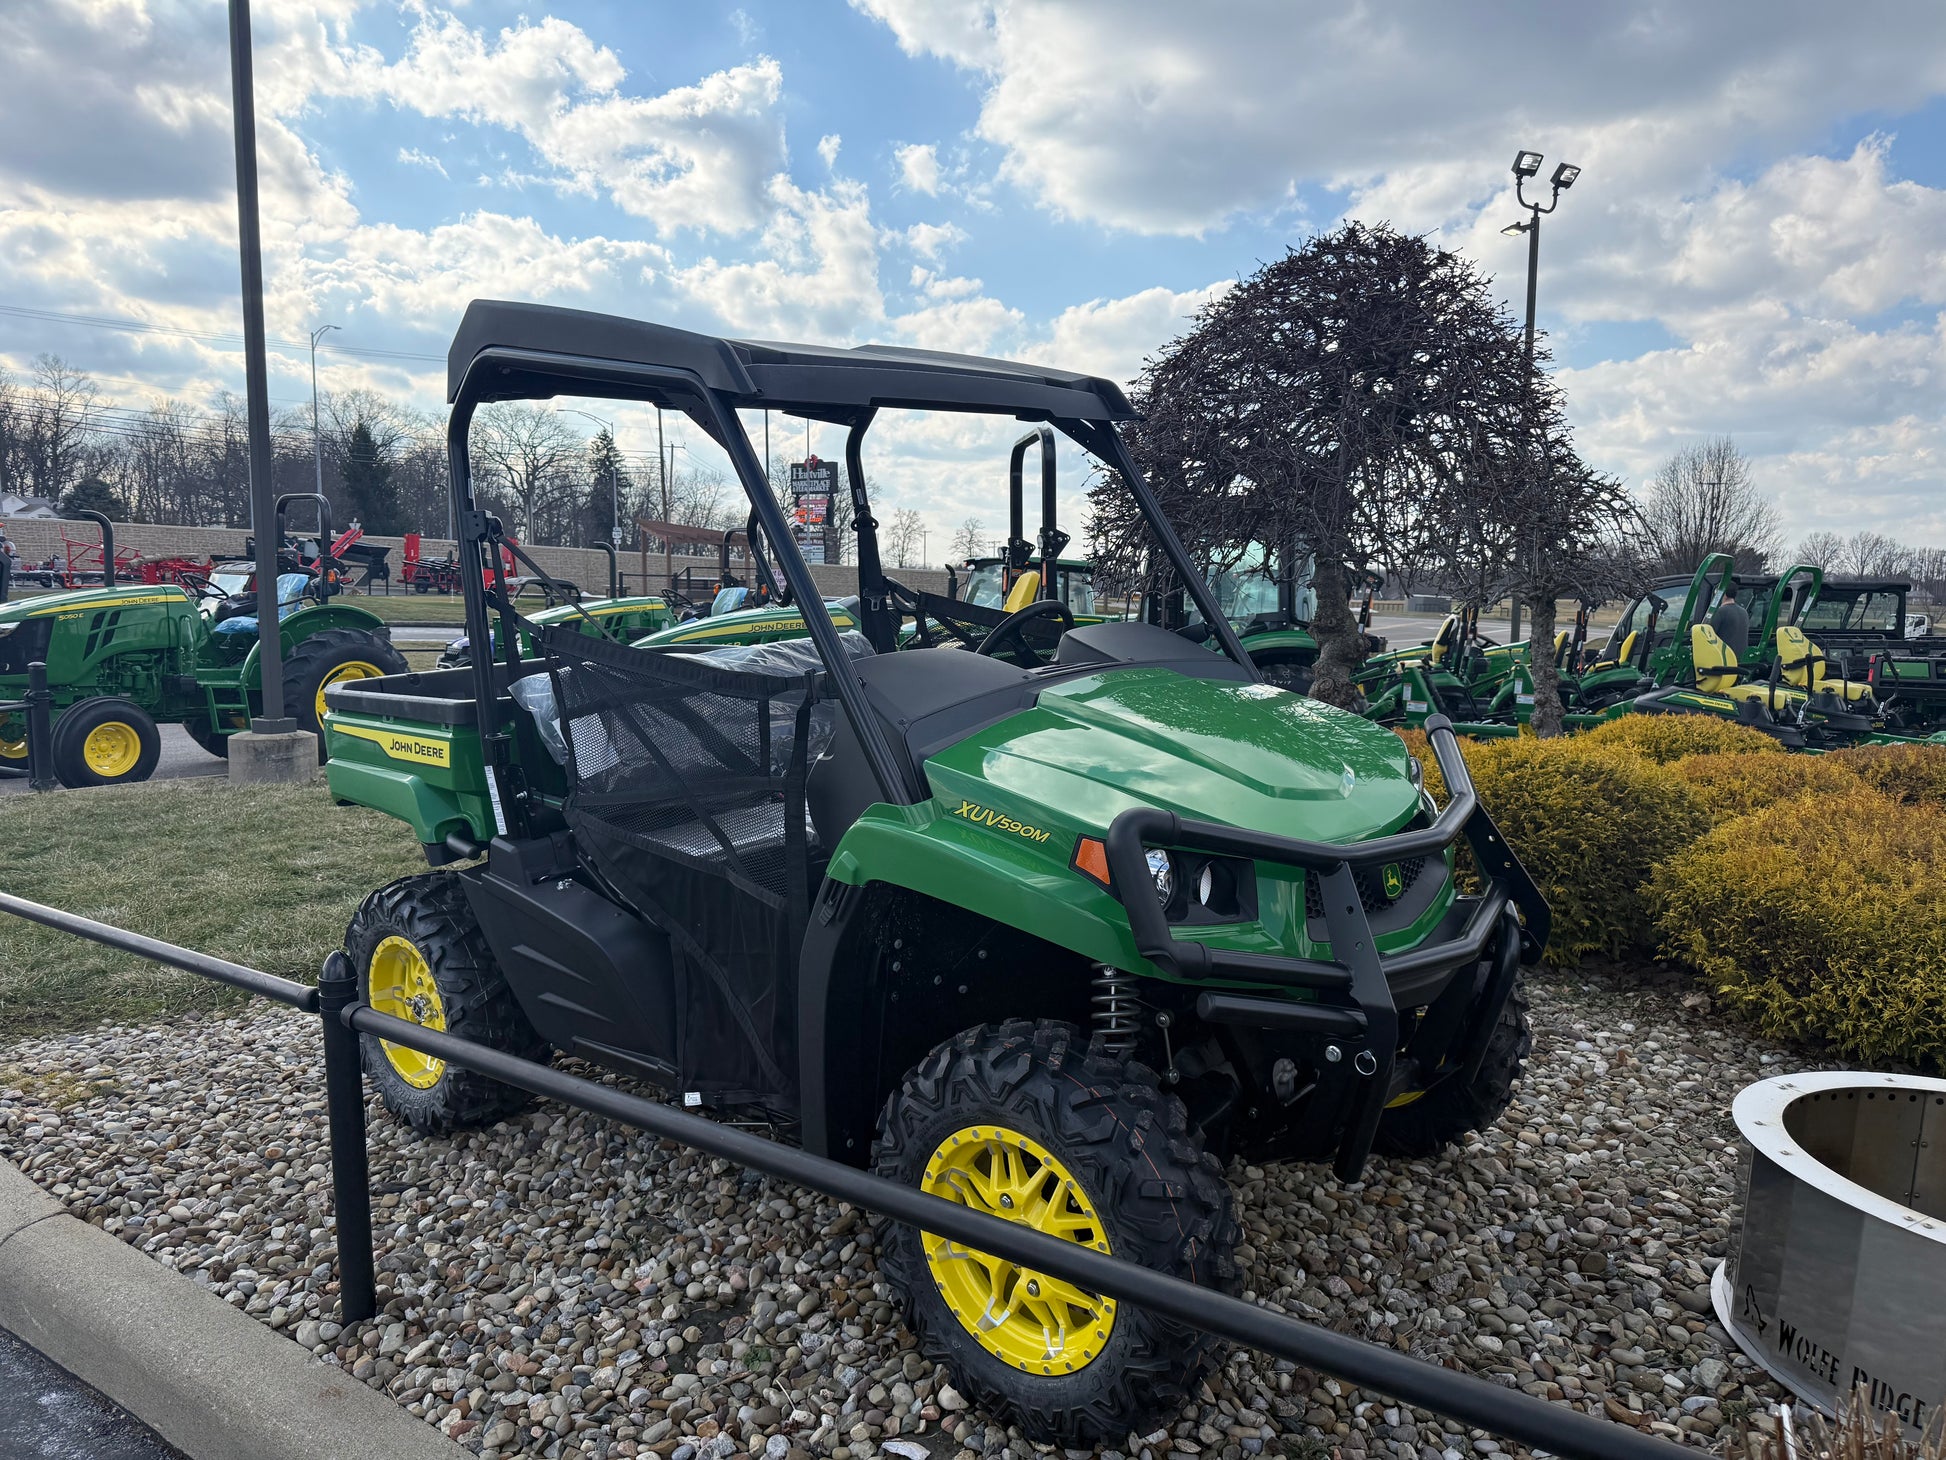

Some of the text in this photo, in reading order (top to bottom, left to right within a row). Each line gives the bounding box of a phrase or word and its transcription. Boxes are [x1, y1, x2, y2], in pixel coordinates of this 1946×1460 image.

[792, 467, 830, 479] Hatville
[748, 624, 774, 633] JOHN
[390, 738, 444, 758] JOHN DEERE
[953, 800, 1051, 843] XUV590M
[1779, 1318, 1840, 1386] WOLFE
